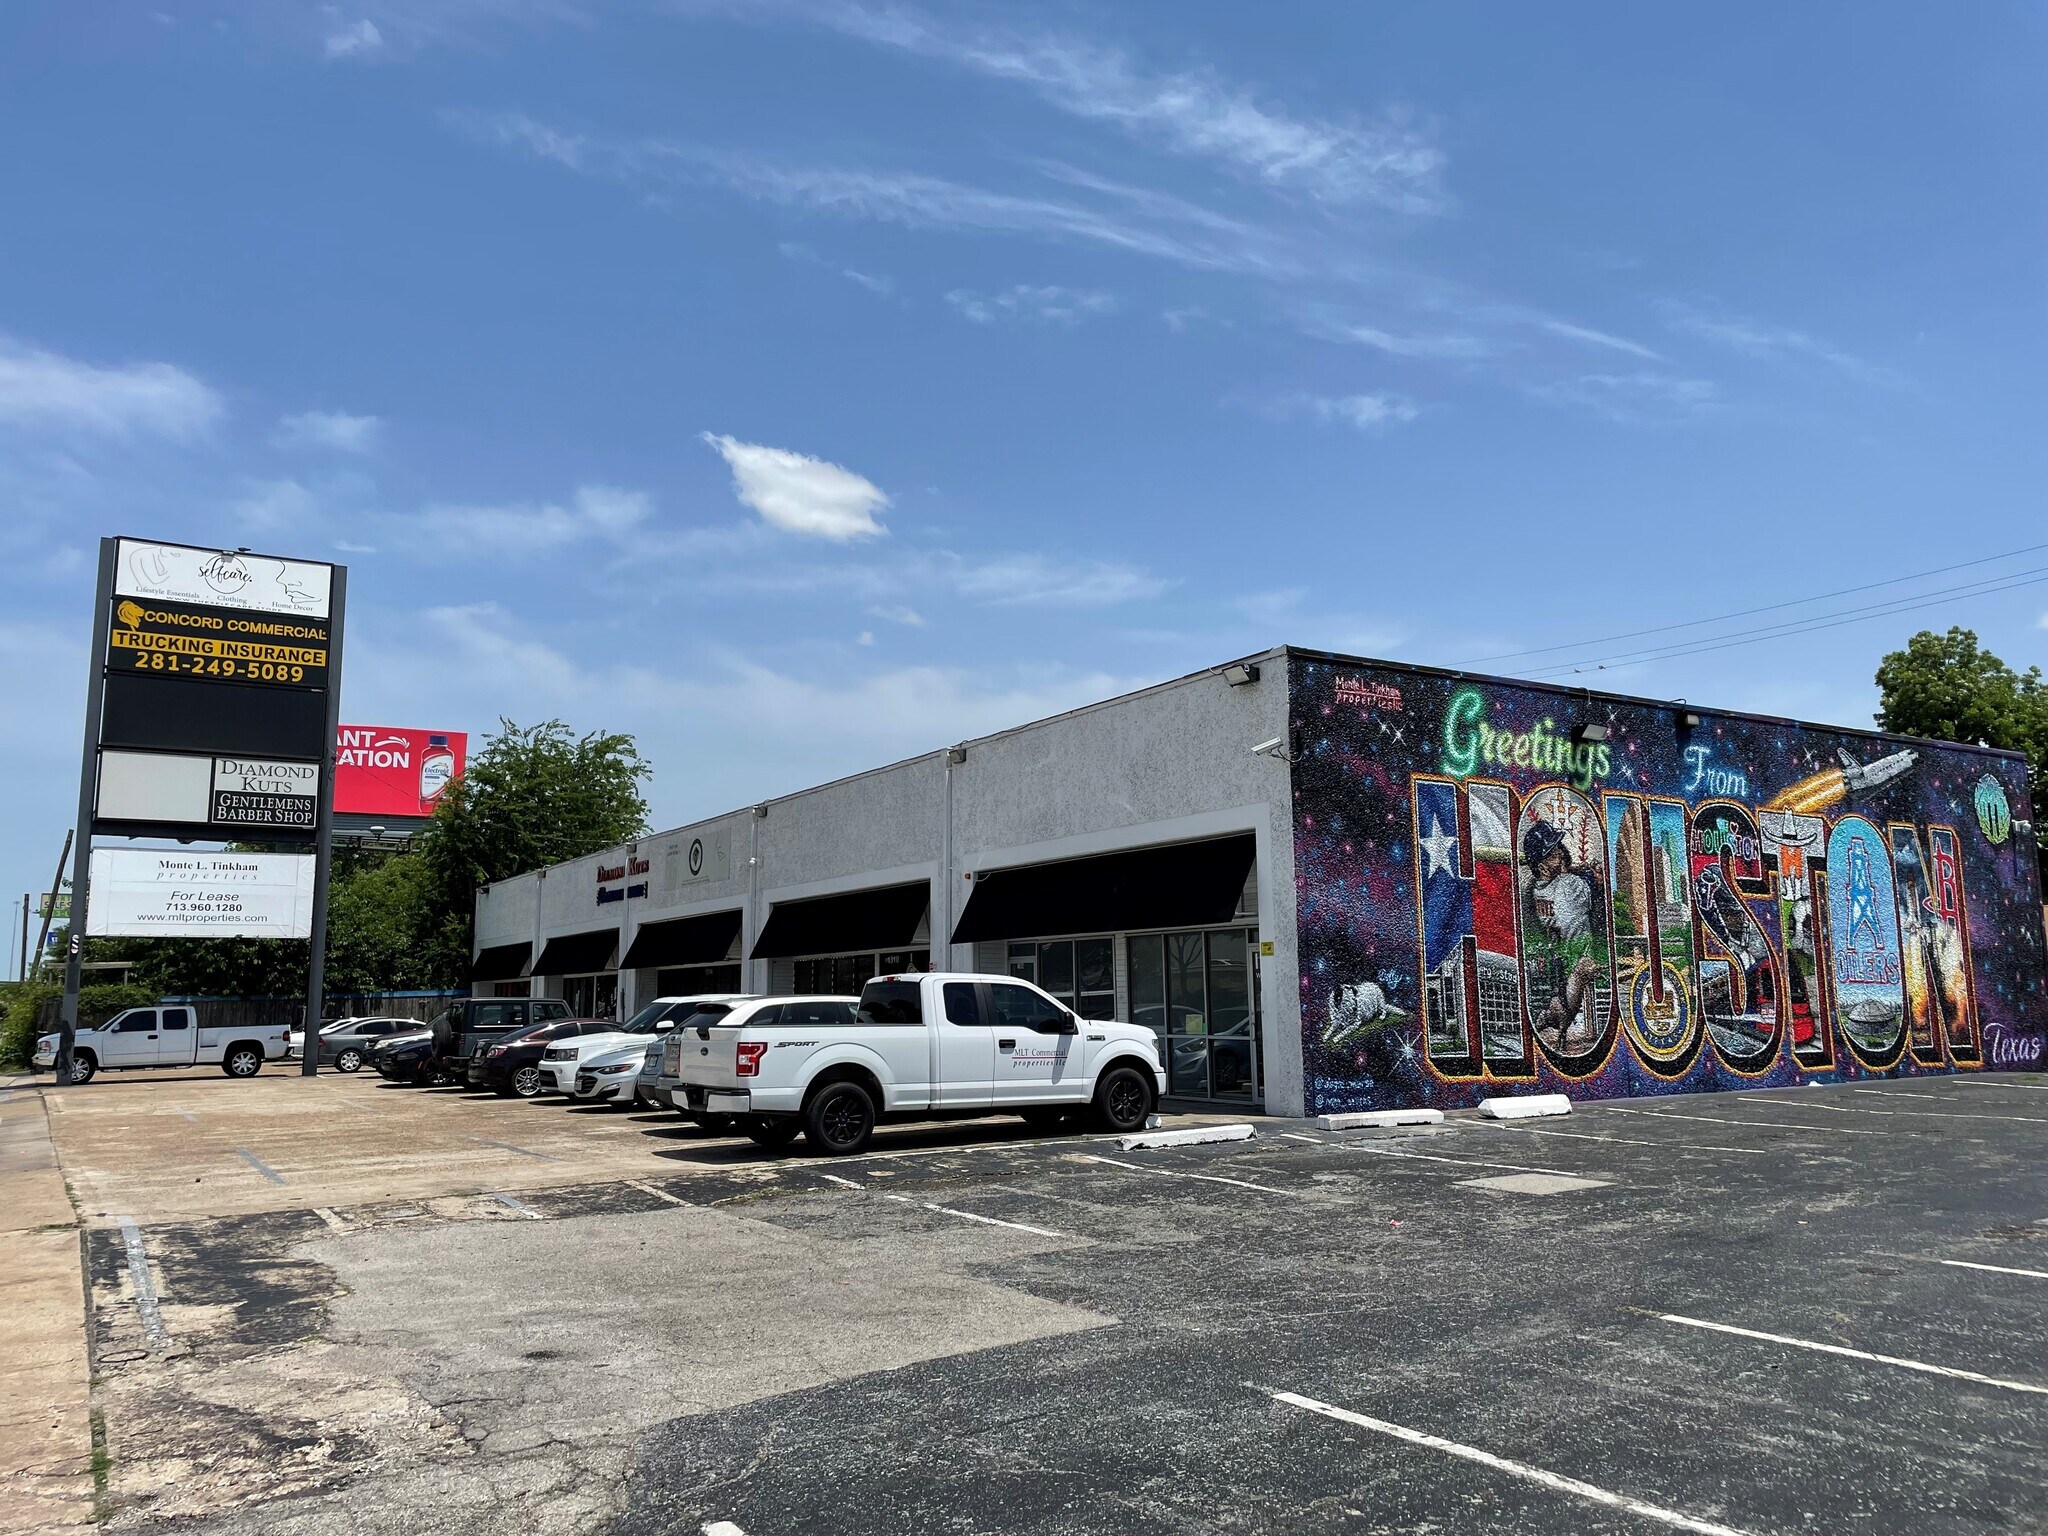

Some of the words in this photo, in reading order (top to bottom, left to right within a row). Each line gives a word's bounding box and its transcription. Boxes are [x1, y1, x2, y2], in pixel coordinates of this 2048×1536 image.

[135, 586, 165, 596] Lifestyle
[166, 589, 200, 599] Essentials
[216, 595, 248, 605] Clothing
[272, 601, 292, 610] Home
[293, 604, 314, 612] Decor
[144, 610, 223, 630] CONCORD
[227, 619, 328, 640] COMMERCIAL
[116, 632, 214, 654] TRUCKING
[220, 643, 323, 664] INSURANCE
[134, 651, 304, 683] 281-249-5089
[1442, 687, 1611, 791] Greetings
[335, 749, 410, 768] ATION
[221, 760, 315, 779] DIAMOND
[1684, 745, 1746, 797] From
[241, 777, 292, 793] KUTS
[220, 793, 311, 811] GENTLEMENS
[217, 806, 272, 822] BARBER
[275, 809, 312, 824] SHOP
[158, 860, 194, 870] Monte
[196, 861, 208, 870] L.
[210, 861, 258, 871] Tinkham
[156, 872, 258, 881] properties
[170, 890, 195, 901] For
[197, 891, 240, 902] Lease
[165, 903, 243, 912] 713.960.1280
[137, 913, 268, 923] www.mltproperties.com
[1411, 772, 1985, 1081] HOUSTON
[1836, 951, 1900, 985] OILERS
[774, 1041, 819, 1049] SPORT
[1983, 1022, 2041, 1064] Texas
[1015, 1048, 1029, 1057] MLT
[1031, 1048, 1067, 1057] Commercial
[1012, 1059, 1054, 1069] properties
